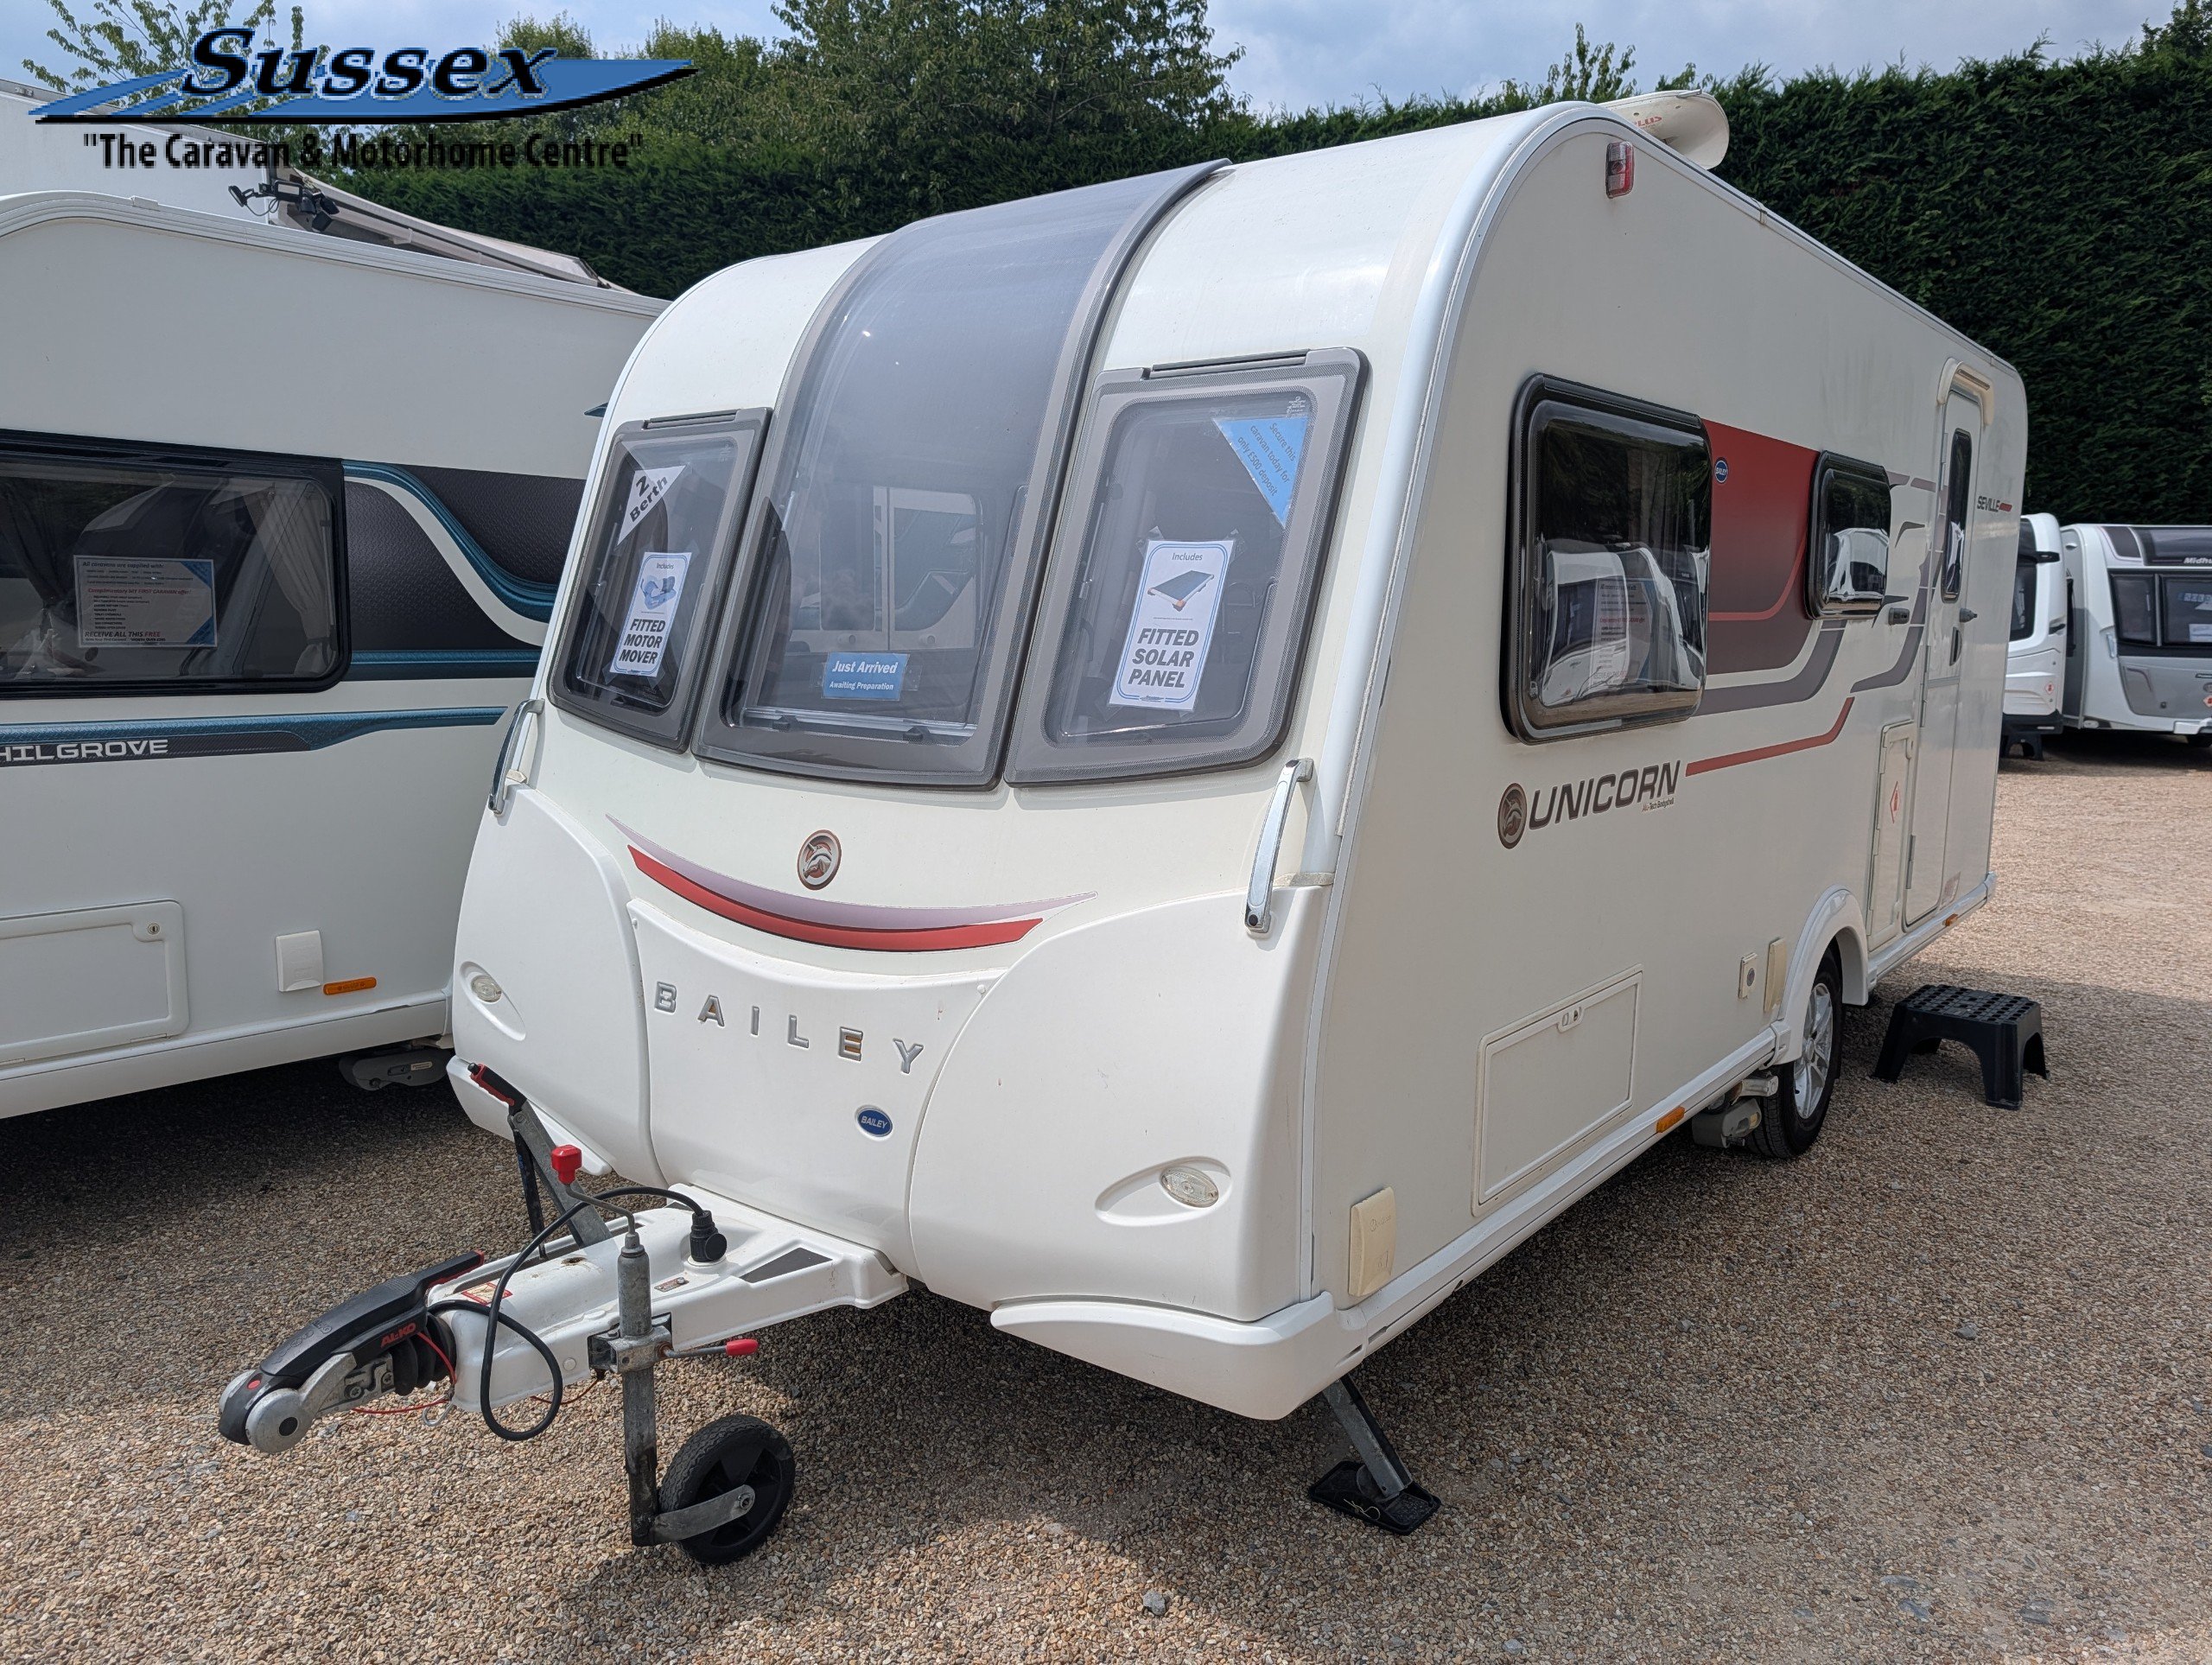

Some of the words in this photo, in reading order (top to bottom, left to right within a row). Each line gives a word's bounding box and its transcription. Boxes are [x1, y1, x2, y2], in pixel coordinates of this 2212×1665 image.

[1269, 422, 1287, 448] Secure
[1285, 446, 1296, 462] this
[1250, 425, 1271, 454] caravan
[1268, 450, 1283, 473] today
[1280, 470, 1291, 484] for
[1237, 436, 1250, 454] only
[1248, 451, 1262, 470] £500
[1258, 468, 1279, 497] deposit
[635, 474, 651, 498] 2
[629, 476, 669, 523] Berth
[1977, 495, 2000, 512] SEVILLE
[1172, 552, 1204, 561] Includes
[630, 618, 666, 633] FITTED
[623, 633, 663, 649] MOTOR
[1137, 627, 1199, 647] FITTED
[618, 649, 658, 664] MOVER
[1132, 648, 1195, 668] SOLAR
[832, 660, 856, 673] Just
[857, 661, 899, 674] Arrived
[830, 681, 856, 690] Awaiting
[856, 682, 894, 690] Preparation
[1128, 669, 1185, 689] PANEL
[1529, 759, 1681, 830] UNICORN
[654, 981, 924, 1075] BAILEY
[861, 1115, 888, 1130] BAILEY
[380, 1322, 416, 1349] AL-KO
